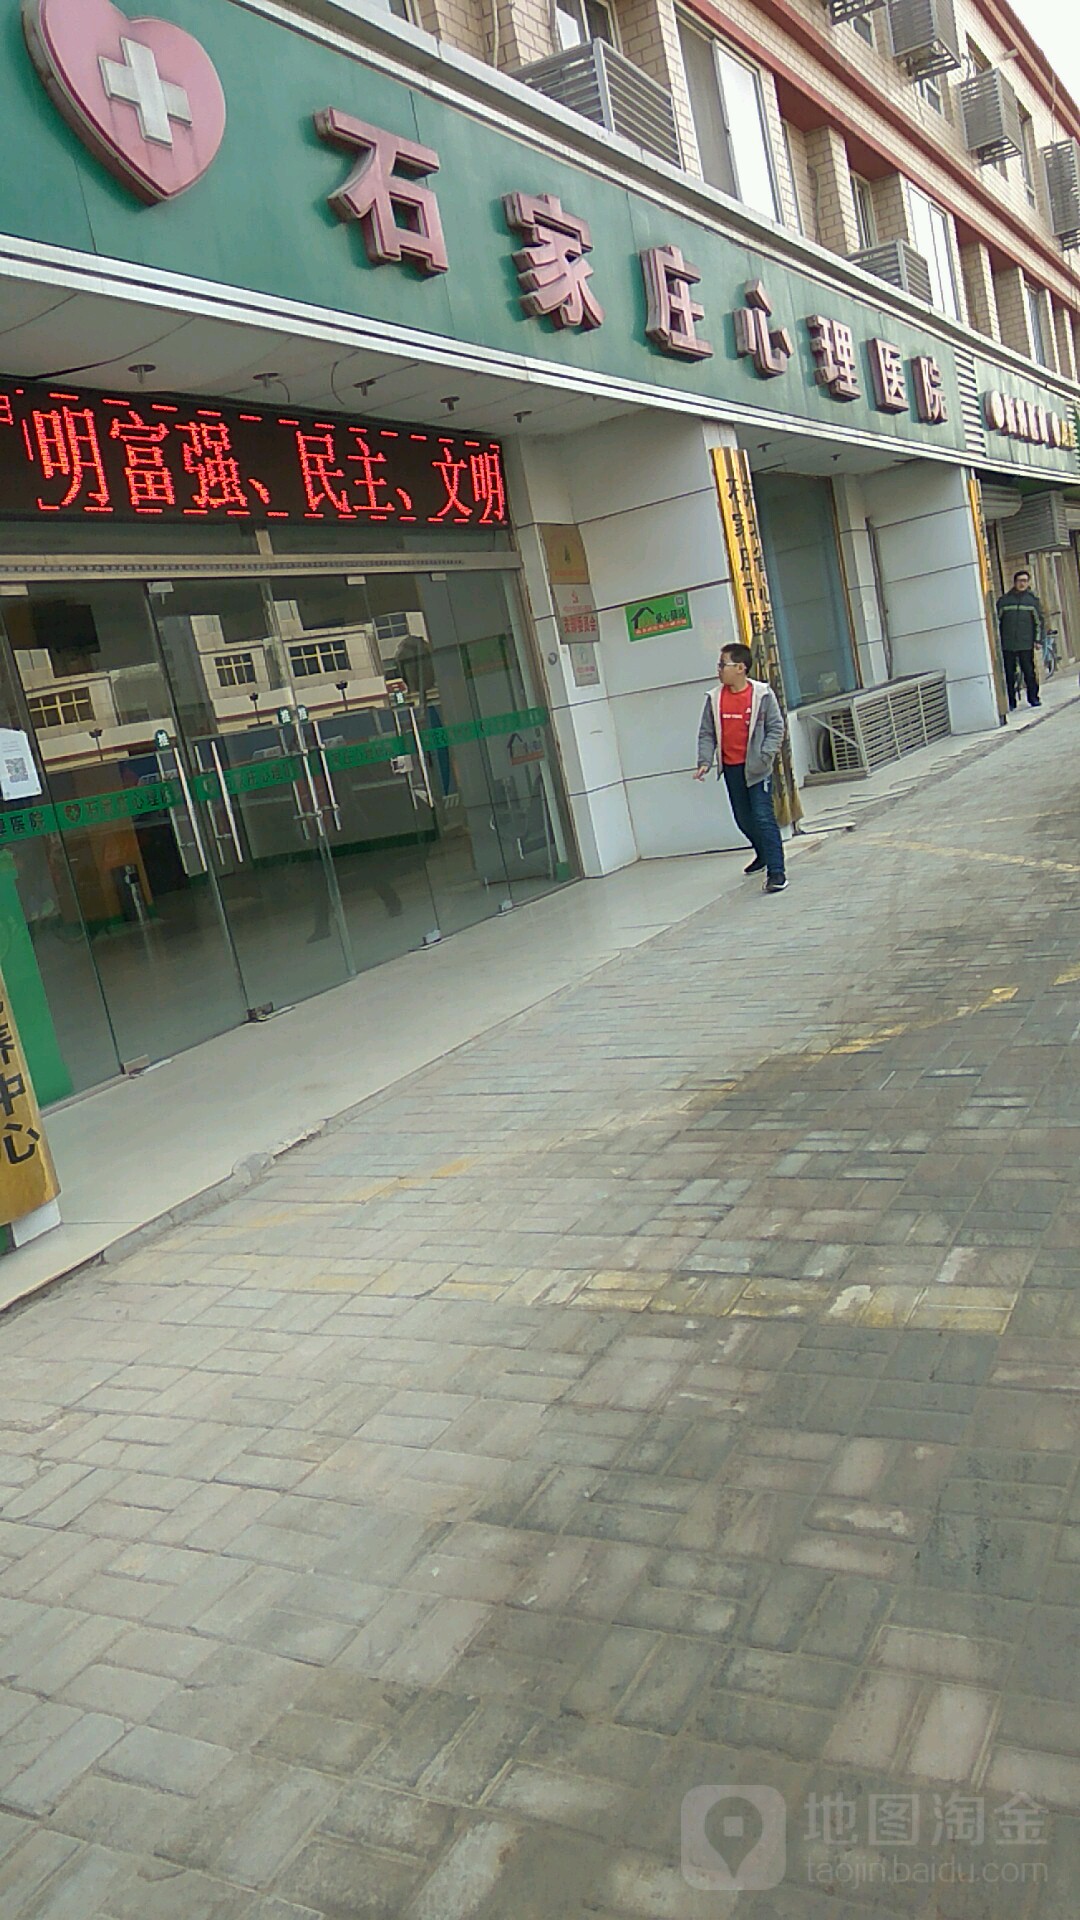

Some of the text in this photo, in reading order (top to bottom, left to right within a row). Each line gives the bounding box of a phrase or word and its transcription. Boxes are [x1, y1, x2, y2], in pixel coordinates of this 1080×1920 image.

[313, 106, 949, 424] 石家庄心理医院
